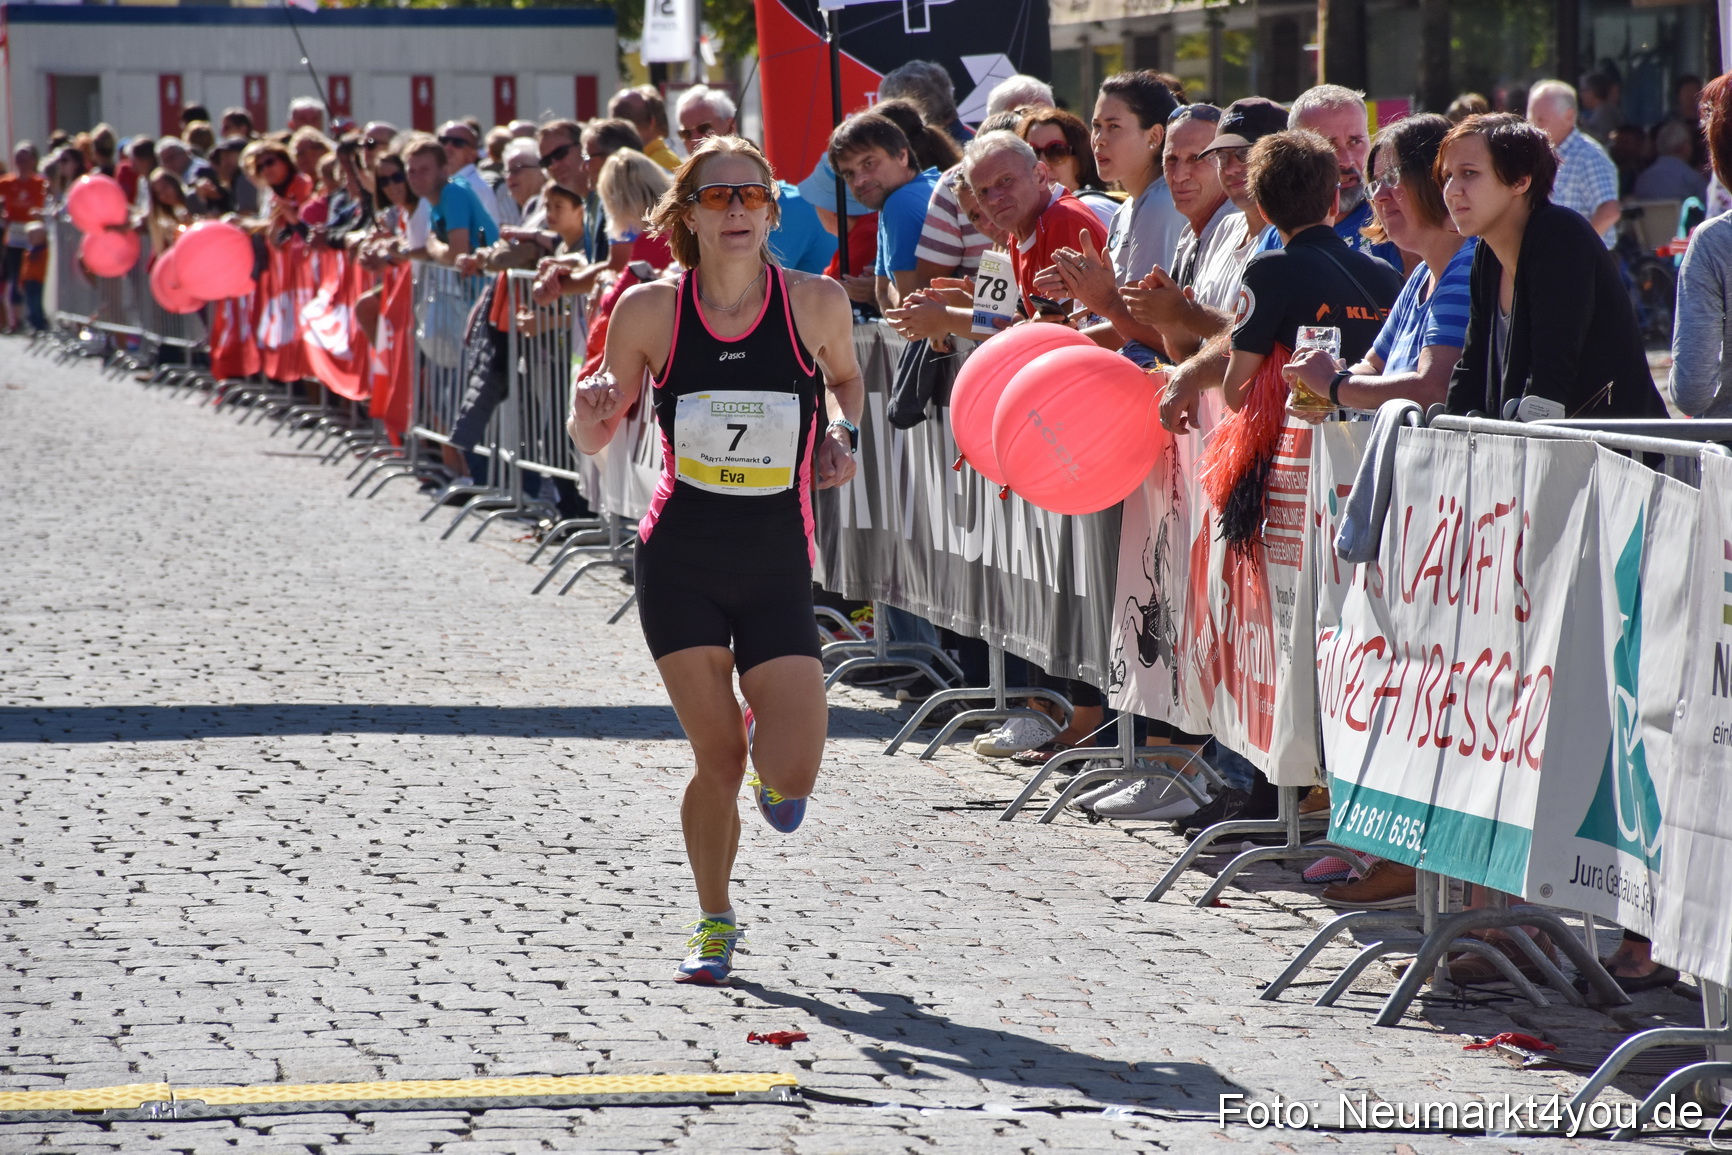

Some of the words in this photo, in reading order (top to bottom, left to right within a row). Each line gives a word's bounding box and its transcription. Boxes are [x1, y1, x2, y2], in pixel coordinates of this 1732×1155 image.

[978, 275, 1008, 301] 78
[711, 401, 764, 414] BOCK
[727, 423, 747, 451] 7
[700, 453, 722, 463] PARTL
[725, 456, 760, 464] Neumarkt
[720, 469, 745, 484] Eva
[1569, 855, 1603, 890] Jura
